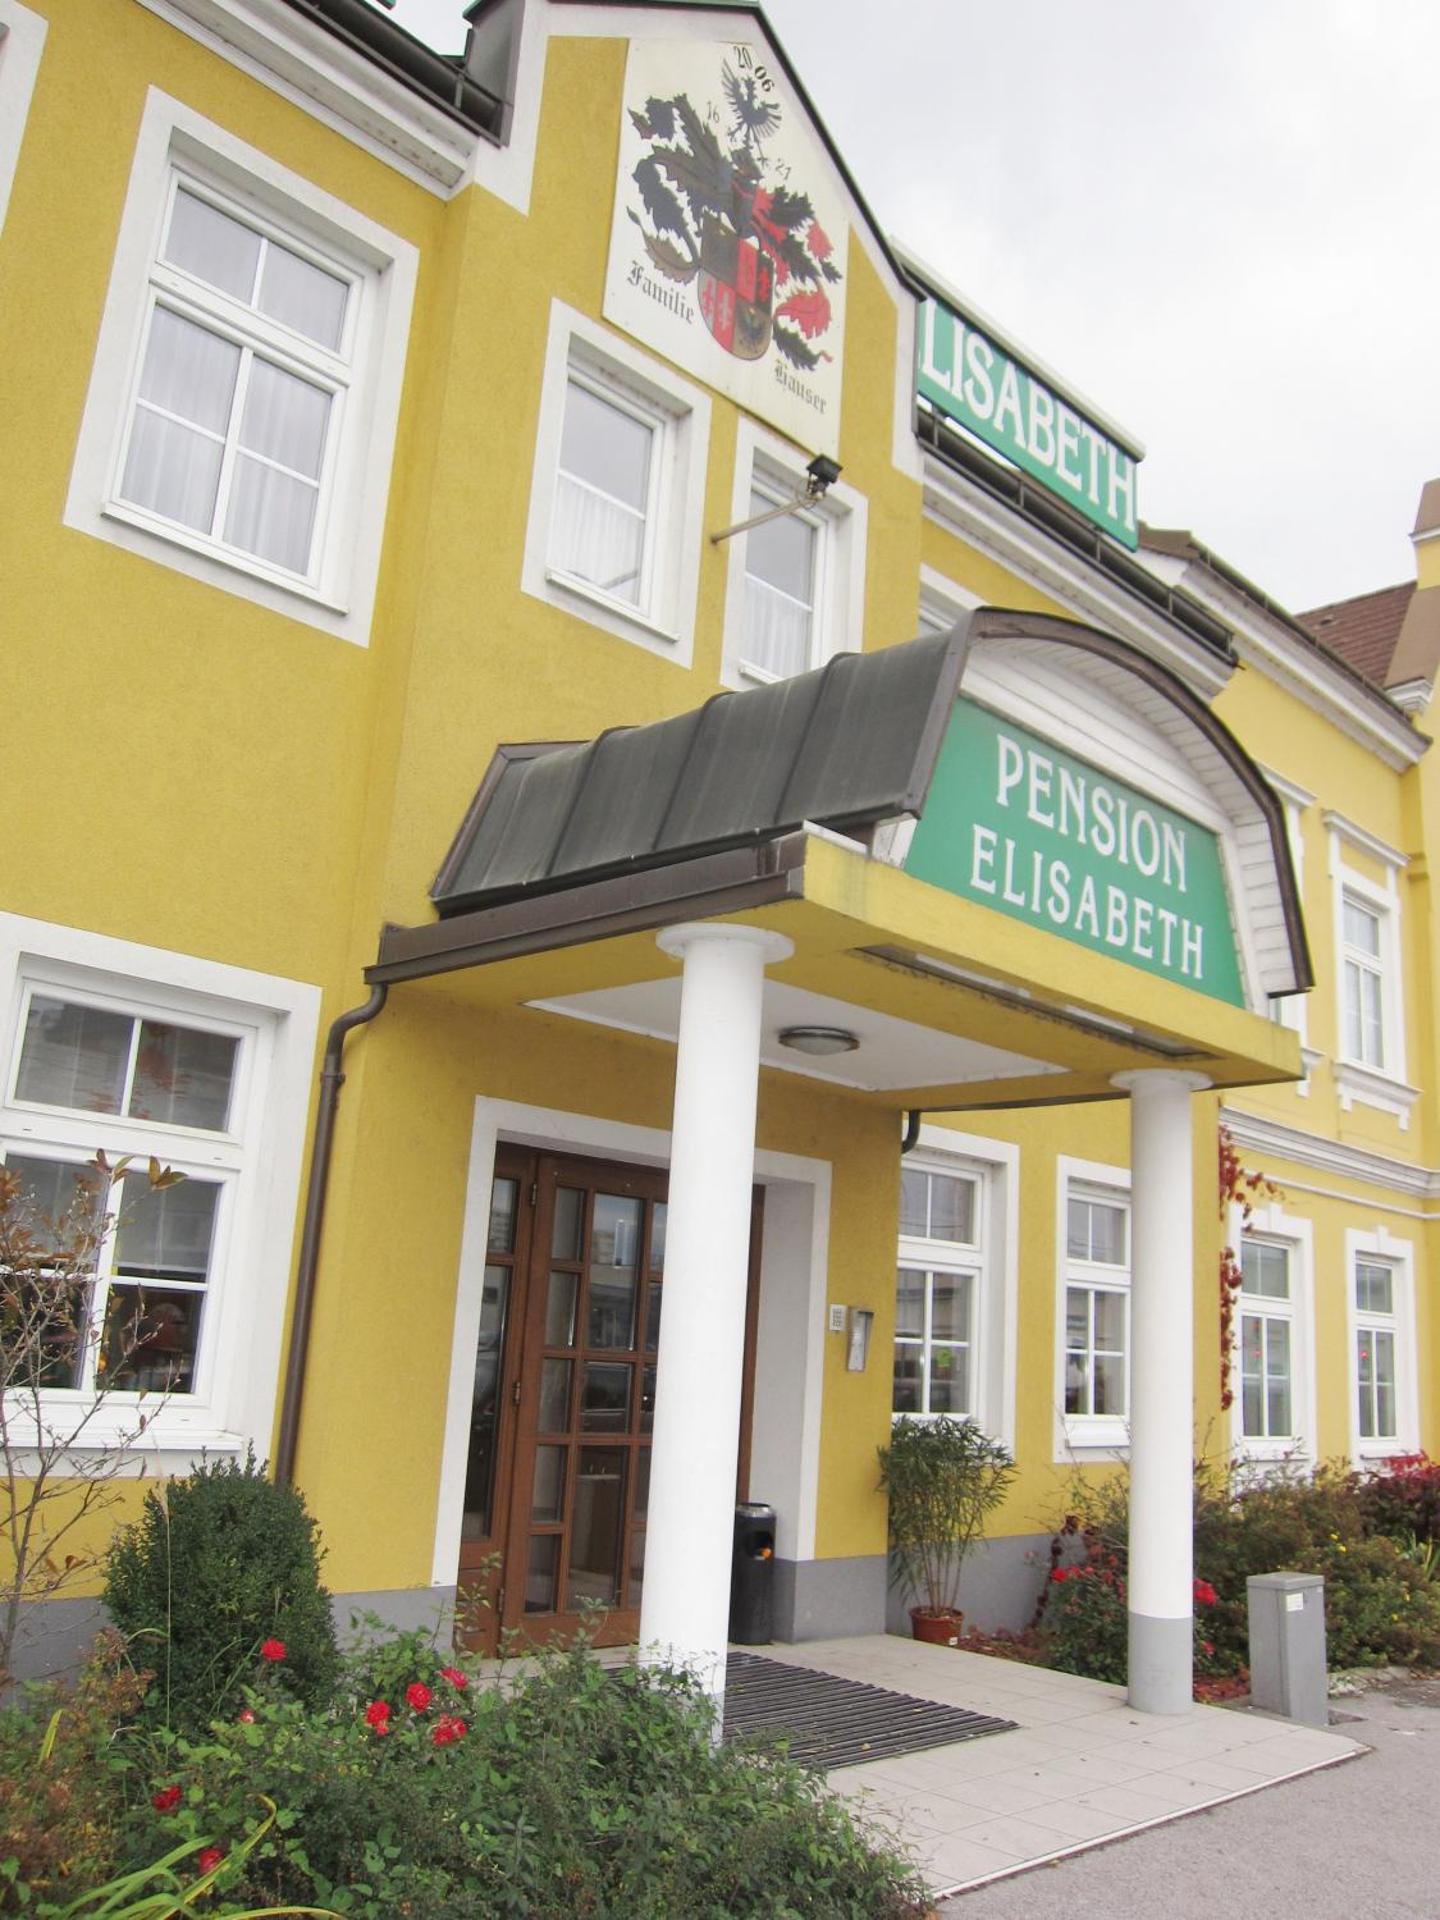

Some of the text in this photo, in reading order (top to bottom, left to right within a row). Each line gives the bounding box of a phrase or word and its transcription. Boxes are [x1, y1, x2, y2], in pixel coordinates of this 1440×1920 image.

[627, 260, 694, 324] Familie
[918, 297, 1136, 533] LISABETH
[996, 733, 1187, 893] PENSION
[970, 823, 1203, 980] ELISABETH
